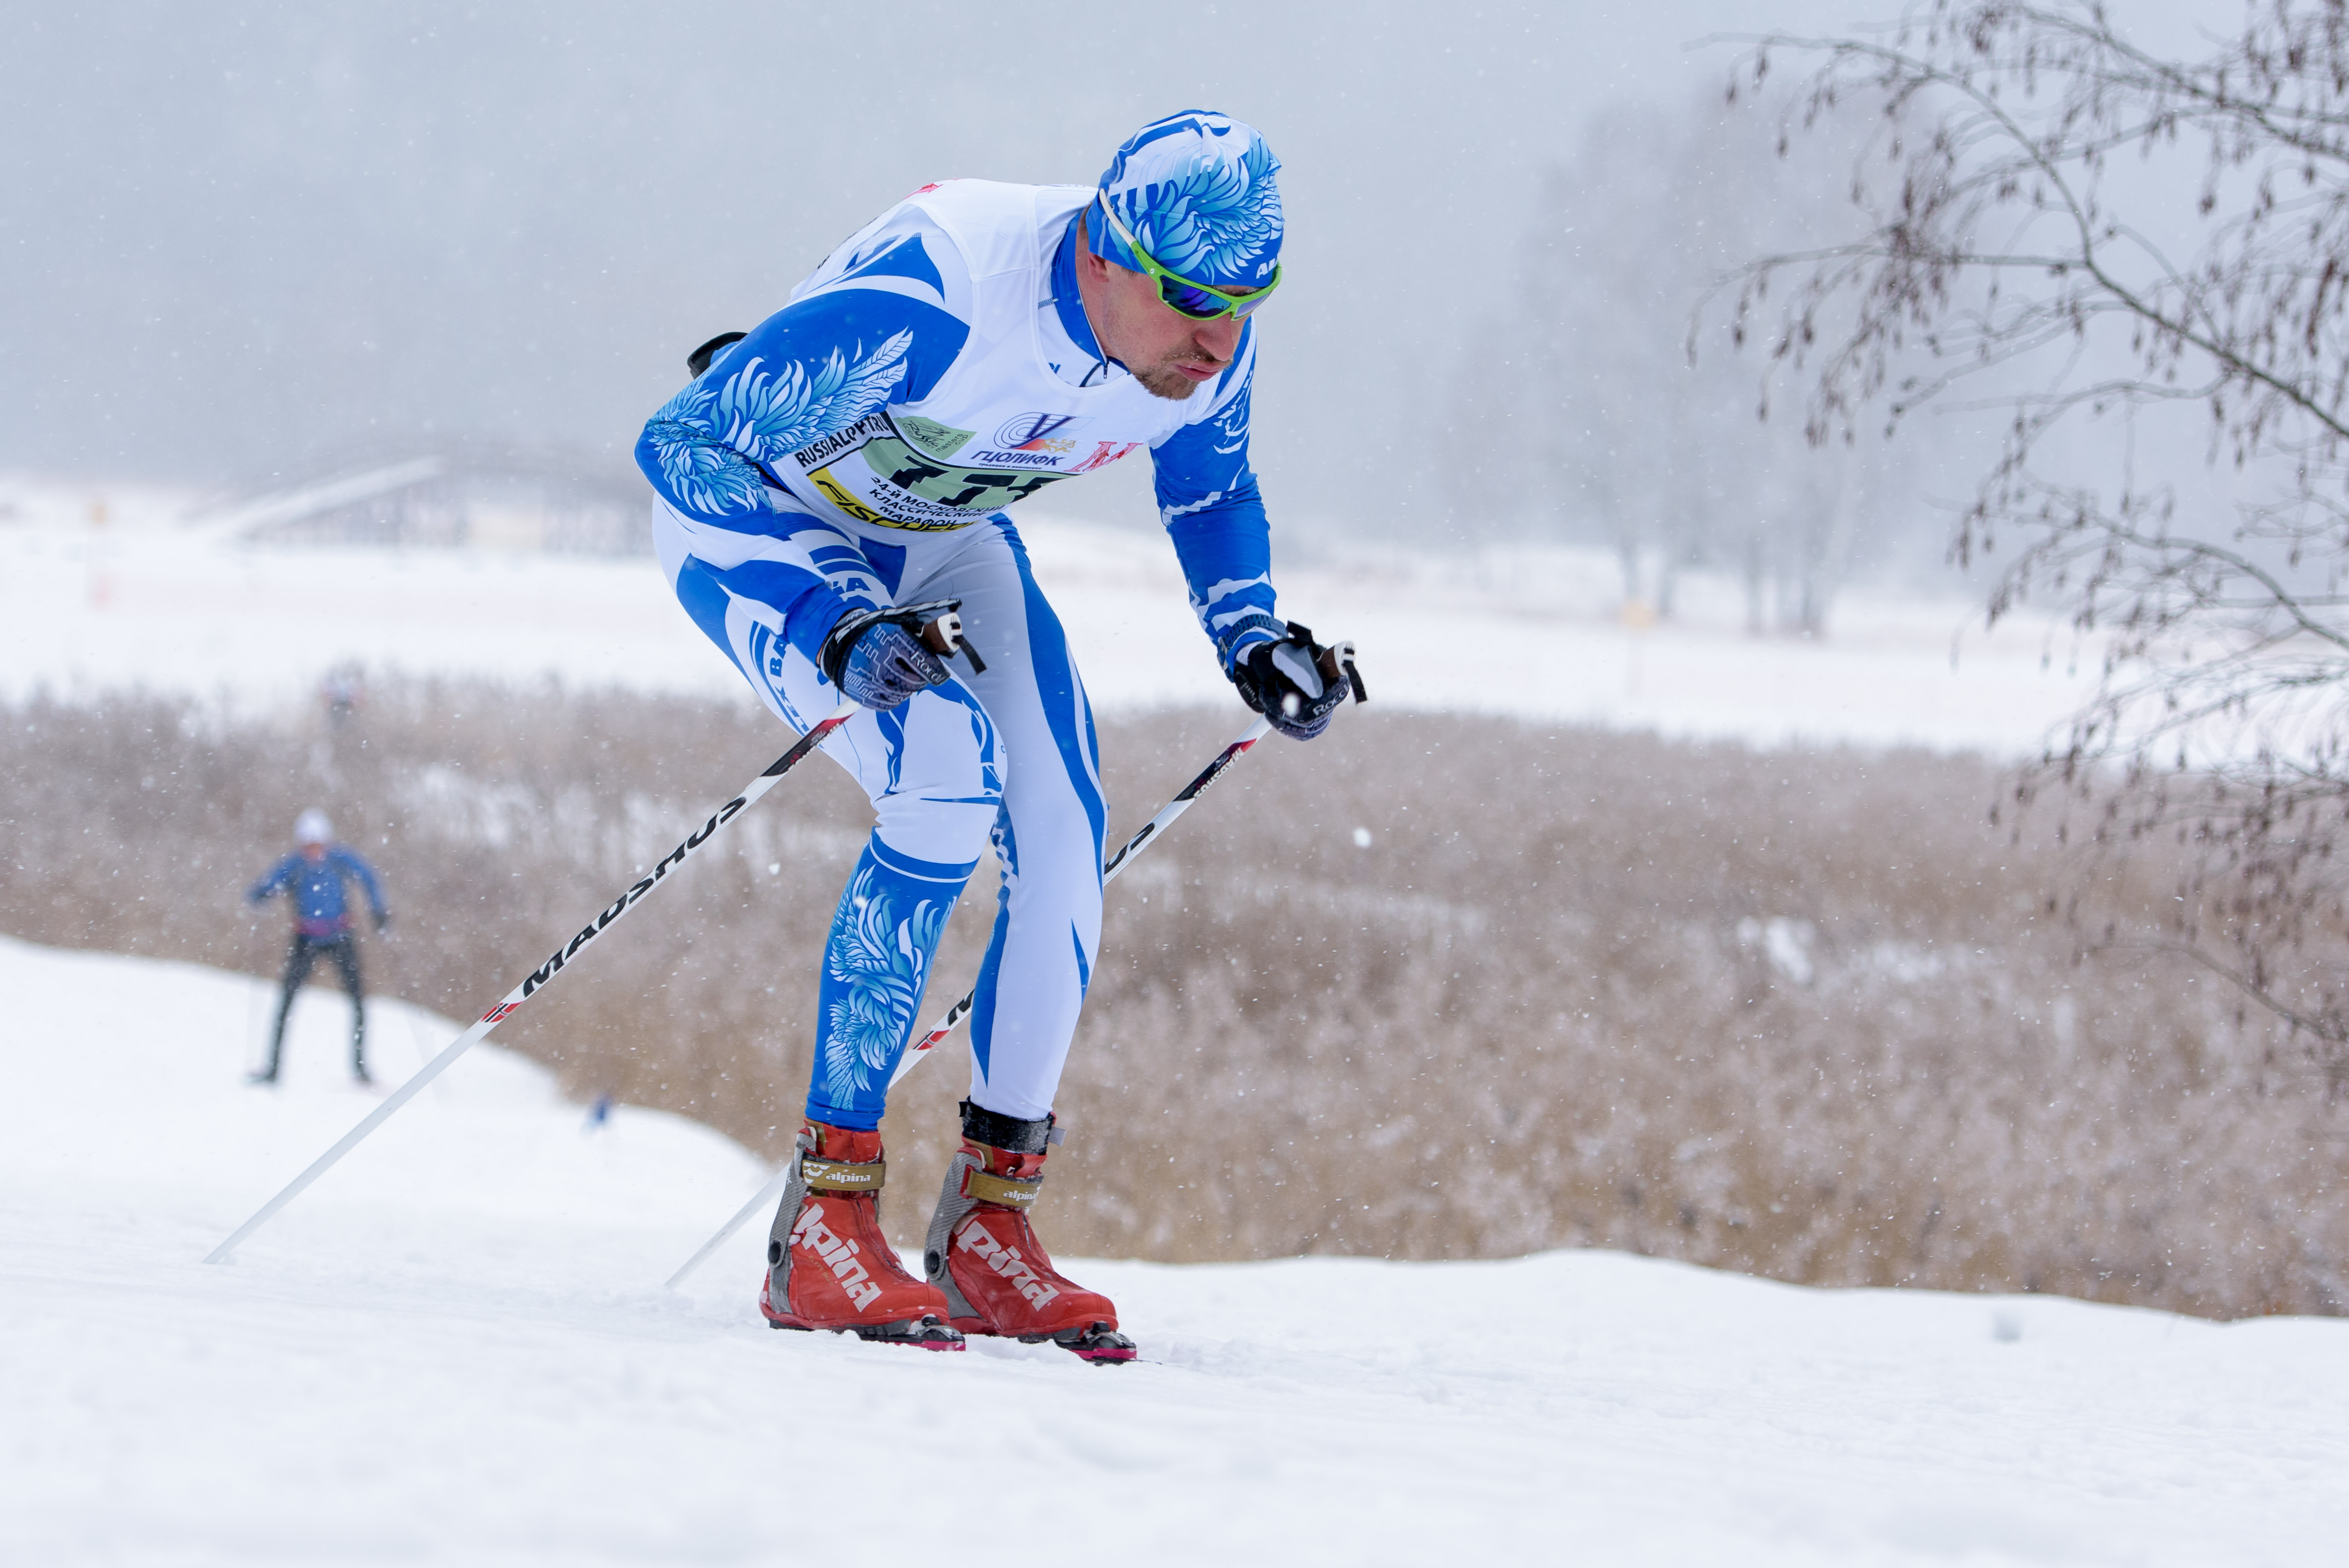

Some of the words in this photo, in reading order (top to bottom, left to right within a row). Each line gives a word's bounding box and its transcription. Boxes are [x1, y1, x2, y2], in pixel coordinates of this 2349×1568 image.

[935, 433, 963, 452] masters
[955, 434, 969, 445] cup
[970, 450, 1066, 467] ГЦОЛИФК
[878, 506, 958, 527] МАРАФОН
[523, 796, 747, 998] MADSHUS
[826, 1172, 871, 1184] alpina
[1003, 1190, 1036, 1201] alpina
